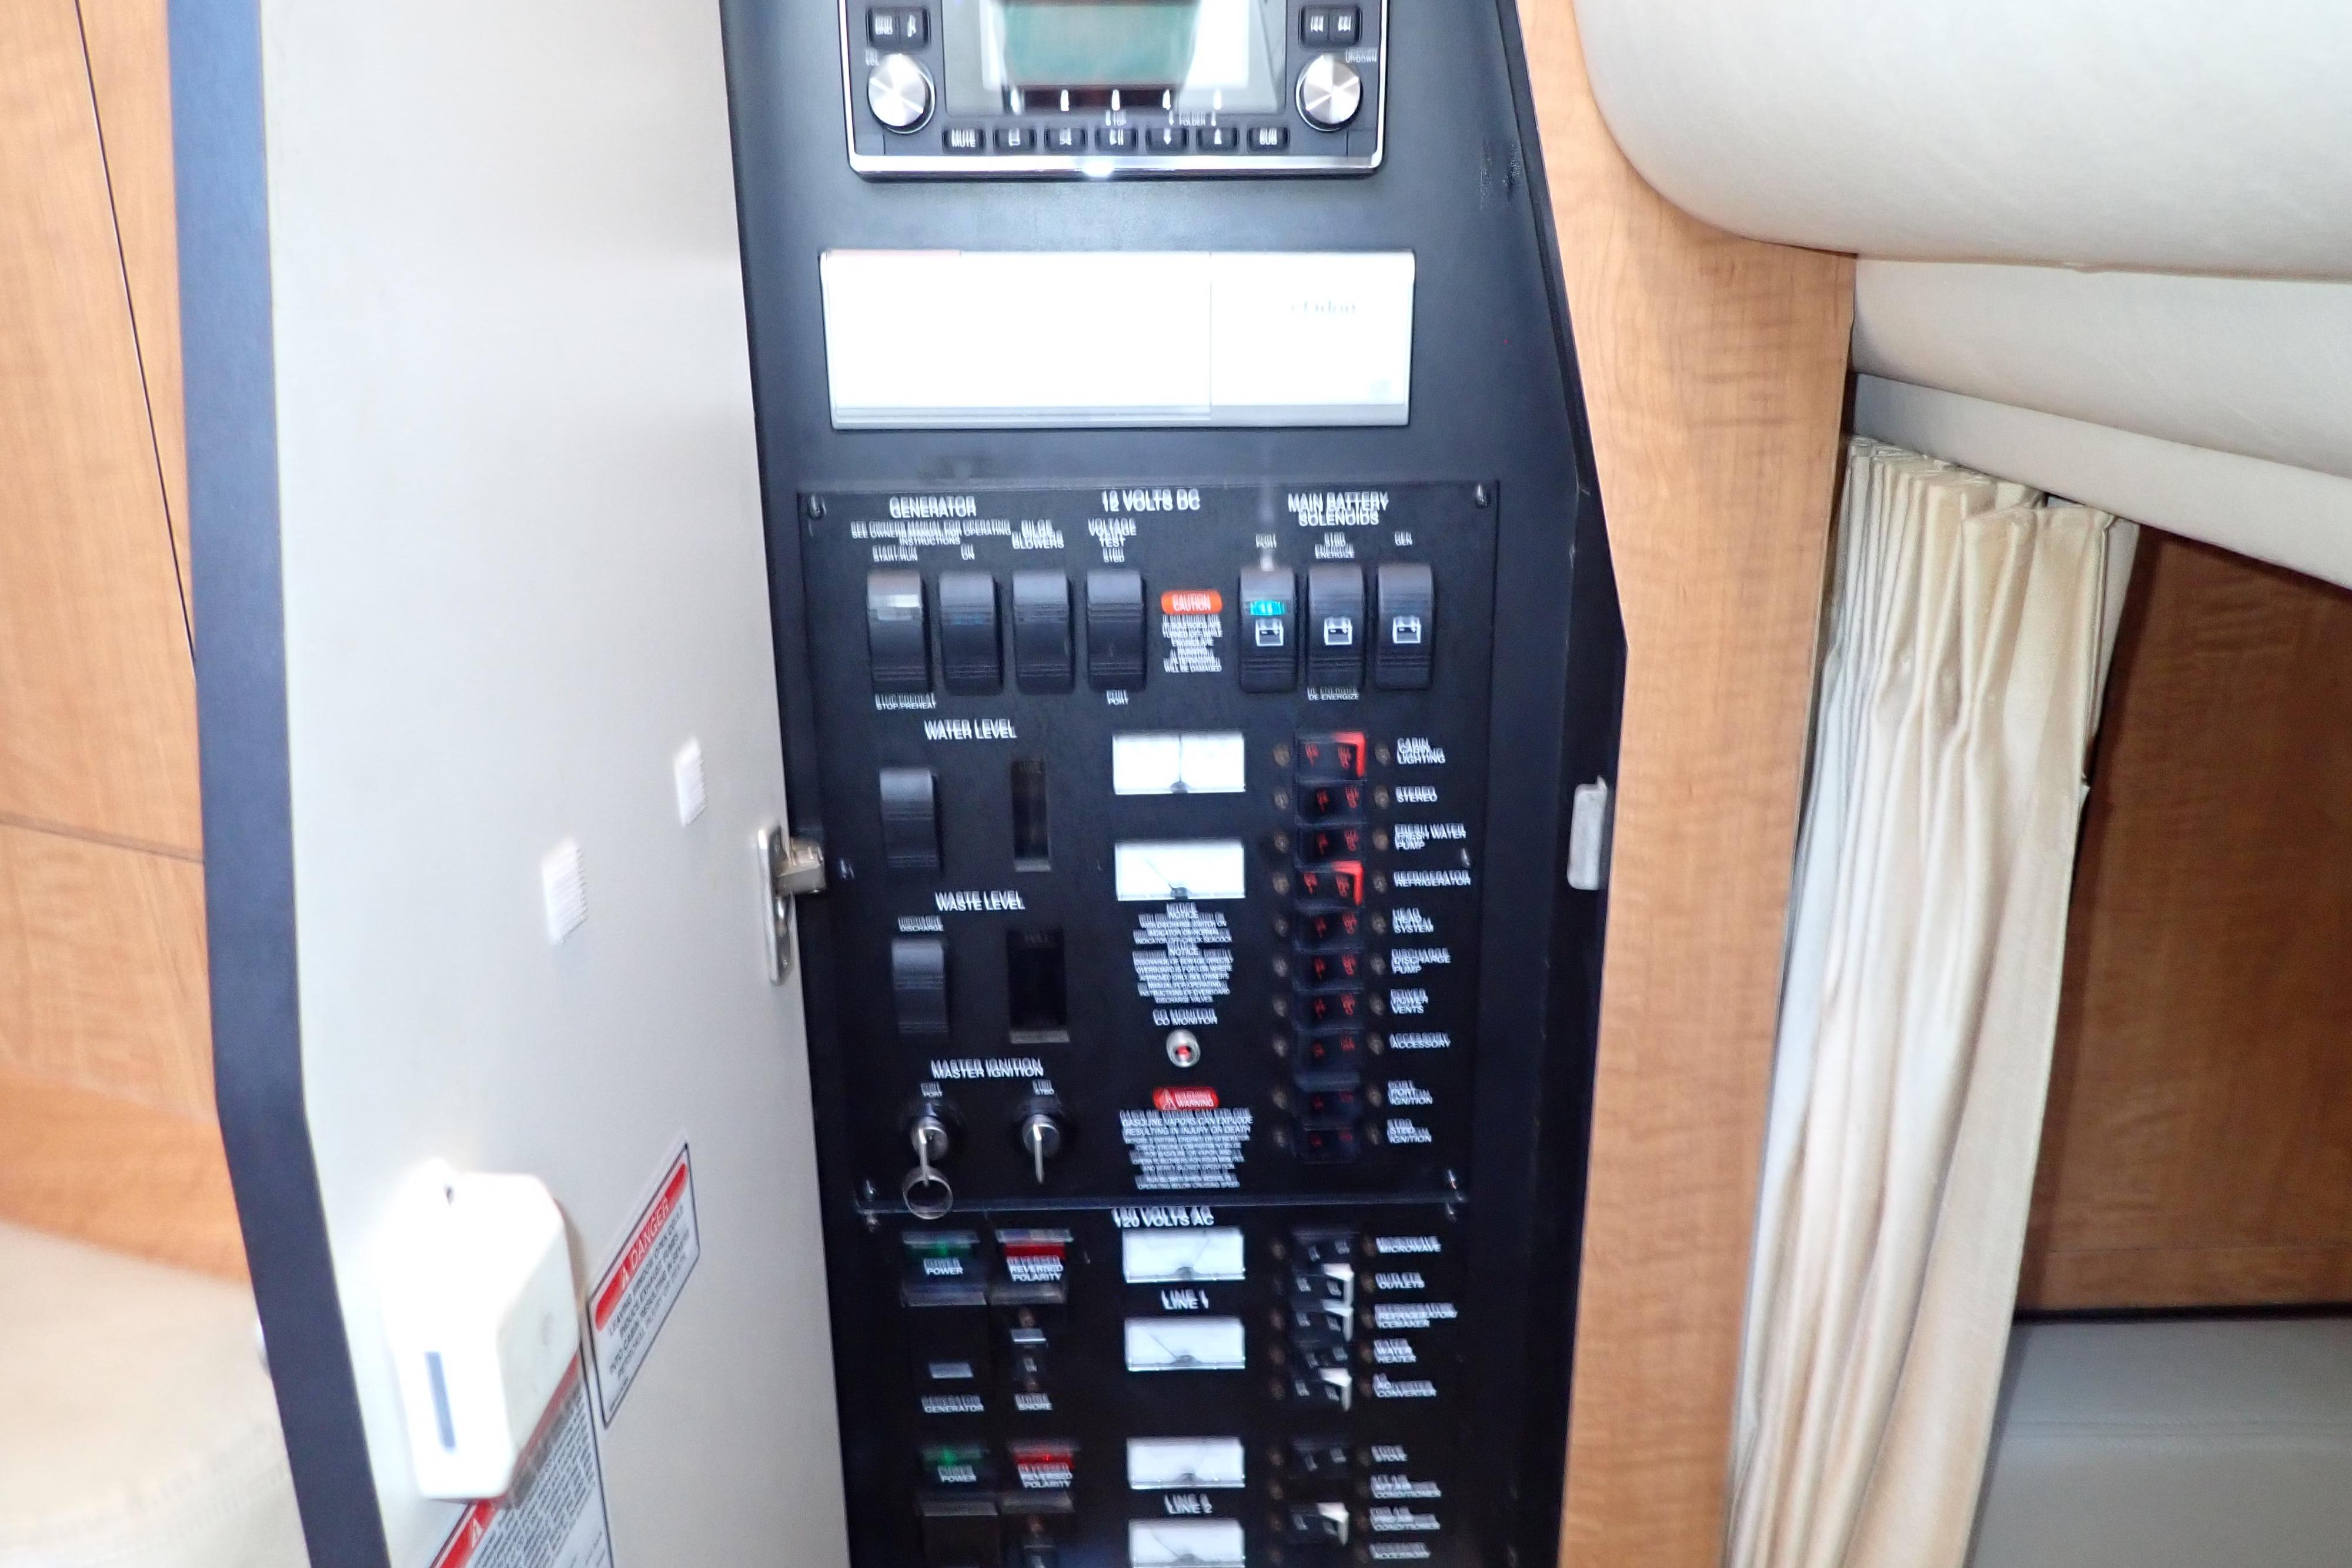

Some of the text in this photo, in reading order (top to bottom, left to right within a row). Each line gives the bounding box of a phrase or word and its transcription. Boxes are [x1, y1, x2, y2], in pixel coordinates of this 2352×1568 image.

[951, 129, 976, 147] MUTE
[1102, 490, 1200, 511] 12 VOLTS DC
[1288, 493, 1388, 511] MAIN BATTERY
[890, 498, 976, 517] GENERATOR
[1299, 510, 1379, 526] SOLENOIDS
[852, 525, 868, 538] SEE
[964, 523, 1011, 536] OPERATING
[1088, 520, 1137, 536] VOLTAGE
[1012, 534, 1064, 548] BLOWERS
[1256, 536, 1277, 547] PORT
[1325, 534, 1346, 546] STBD
[1395, 534, 1412, 546] GEN
[961, 547, 974, 559] ON
[1103, 550, 1124, 562] STBD
[1315, 546, 1354, 559] ENERGIZE
[1172, 594, 1211, 611] CAUTION
[1107, 694, 1128, 705] PORT
[1308, 690, 1359, 700] DE-ENERGIZE
[924, 720, 1017, 740] WATER LEVEL
[1398, 741, 1430, 754] CABIN
[1398, 751, 1445, 764] LIGHTING
[1396, 790, 1437, 802] STEREO
[1395, 827, 1466, 839] FRESH WATER
[1395, 838, 1425, 850] PUMP
[1395, 874, 1470, 887] REFRIGERATOR
[935, 892, 1025, 911] WASTE LEVEL
[1394, 912, 1422, 924] HEAD
[899, 920, 943, 931] DISCHARGE
[1394, 921, 1434, 933] SYSTEM
[1392, 952, 1451, 964] DISCHARGE
[1392, 962, 1422, 974] PUMP
[1391, 991, 1428, 1004] POWER
[1392, 1002, 1424, 1014] VENTS
[1154, 1012, 1217, 1025] CO MONITOR
[1390, 1037, 1451, 1049] ACCESSORY
[932, 1062, 1043, 1078] MASTER IGNITION
[922, 1085, 942, 1097] PORT
[1034, 1084, 1054, 1095] STBD
[1389, 1085, 1416, 1096] PORT
[1175, 1095, 1214, 1107] WARNING
[1389, 1092, 1432, 1105] IGNITION
[1388, 1132, 1431, 1143] IGNITION
[1112, 1212, 1214, 1228] 120 VOLTS AC
[630, 1193, 669, 1273] DANGER
[1377, 1239, 1441, 1253] MICROWAVE
[924, 1261, 963, 1275] POWER
[1008, 1259, 1063, 1273] REVERSED
[1011, 1272, 1062, 1282] POLARITY
[1376, 1276, 1425, 1289] OUTLETS
[1162, 1292, 1198, 1310] LINE
[1374, 1342, 1412, 1354] WATER
[1375, 1353, 1416, 1363] HEATER
[923, 1399, 984, 1413] GENERATOR
[939, 1468, 976, 1482] POWER
[1165, 1496, 1200, 1514] LINE
